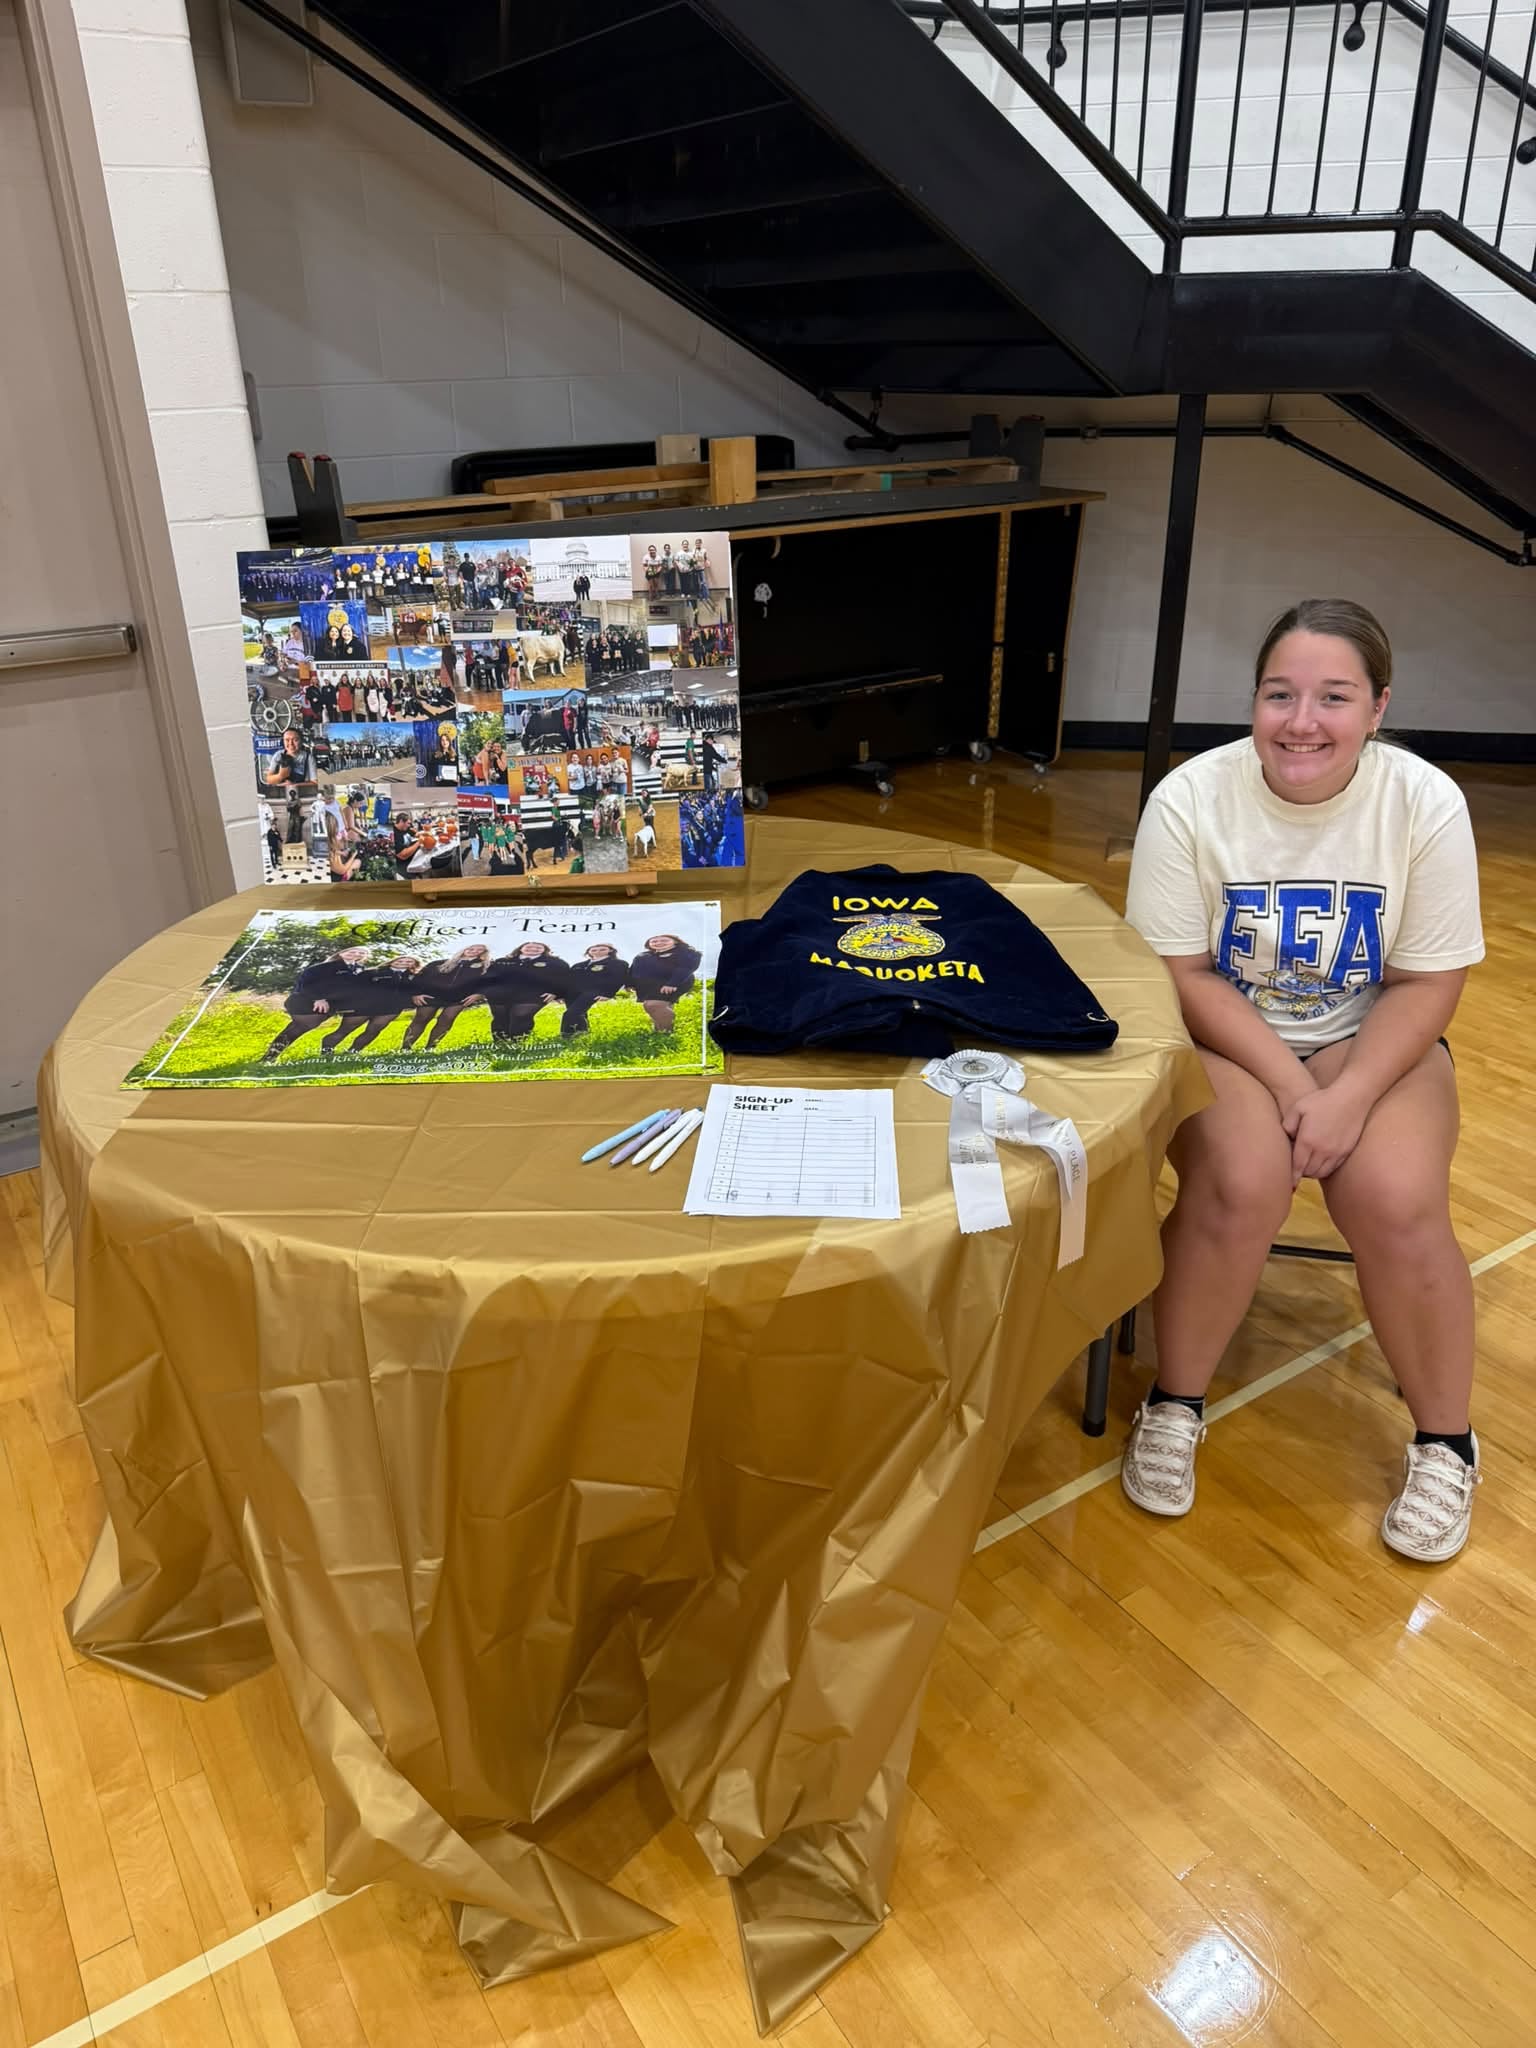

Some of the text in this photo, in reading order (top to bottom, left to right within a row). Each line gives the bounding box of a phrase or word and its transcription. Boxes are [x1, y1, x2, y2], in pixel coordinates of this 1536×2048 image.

[832, 895, 940, 912] IOWA
[351, 918, 617, 939] Officer Team
[1215, 880, 1387, 995] FFA
[732, 1103, 779, 1112] SHEET
[734, 1095, 794, 1104] SIGN-UP
